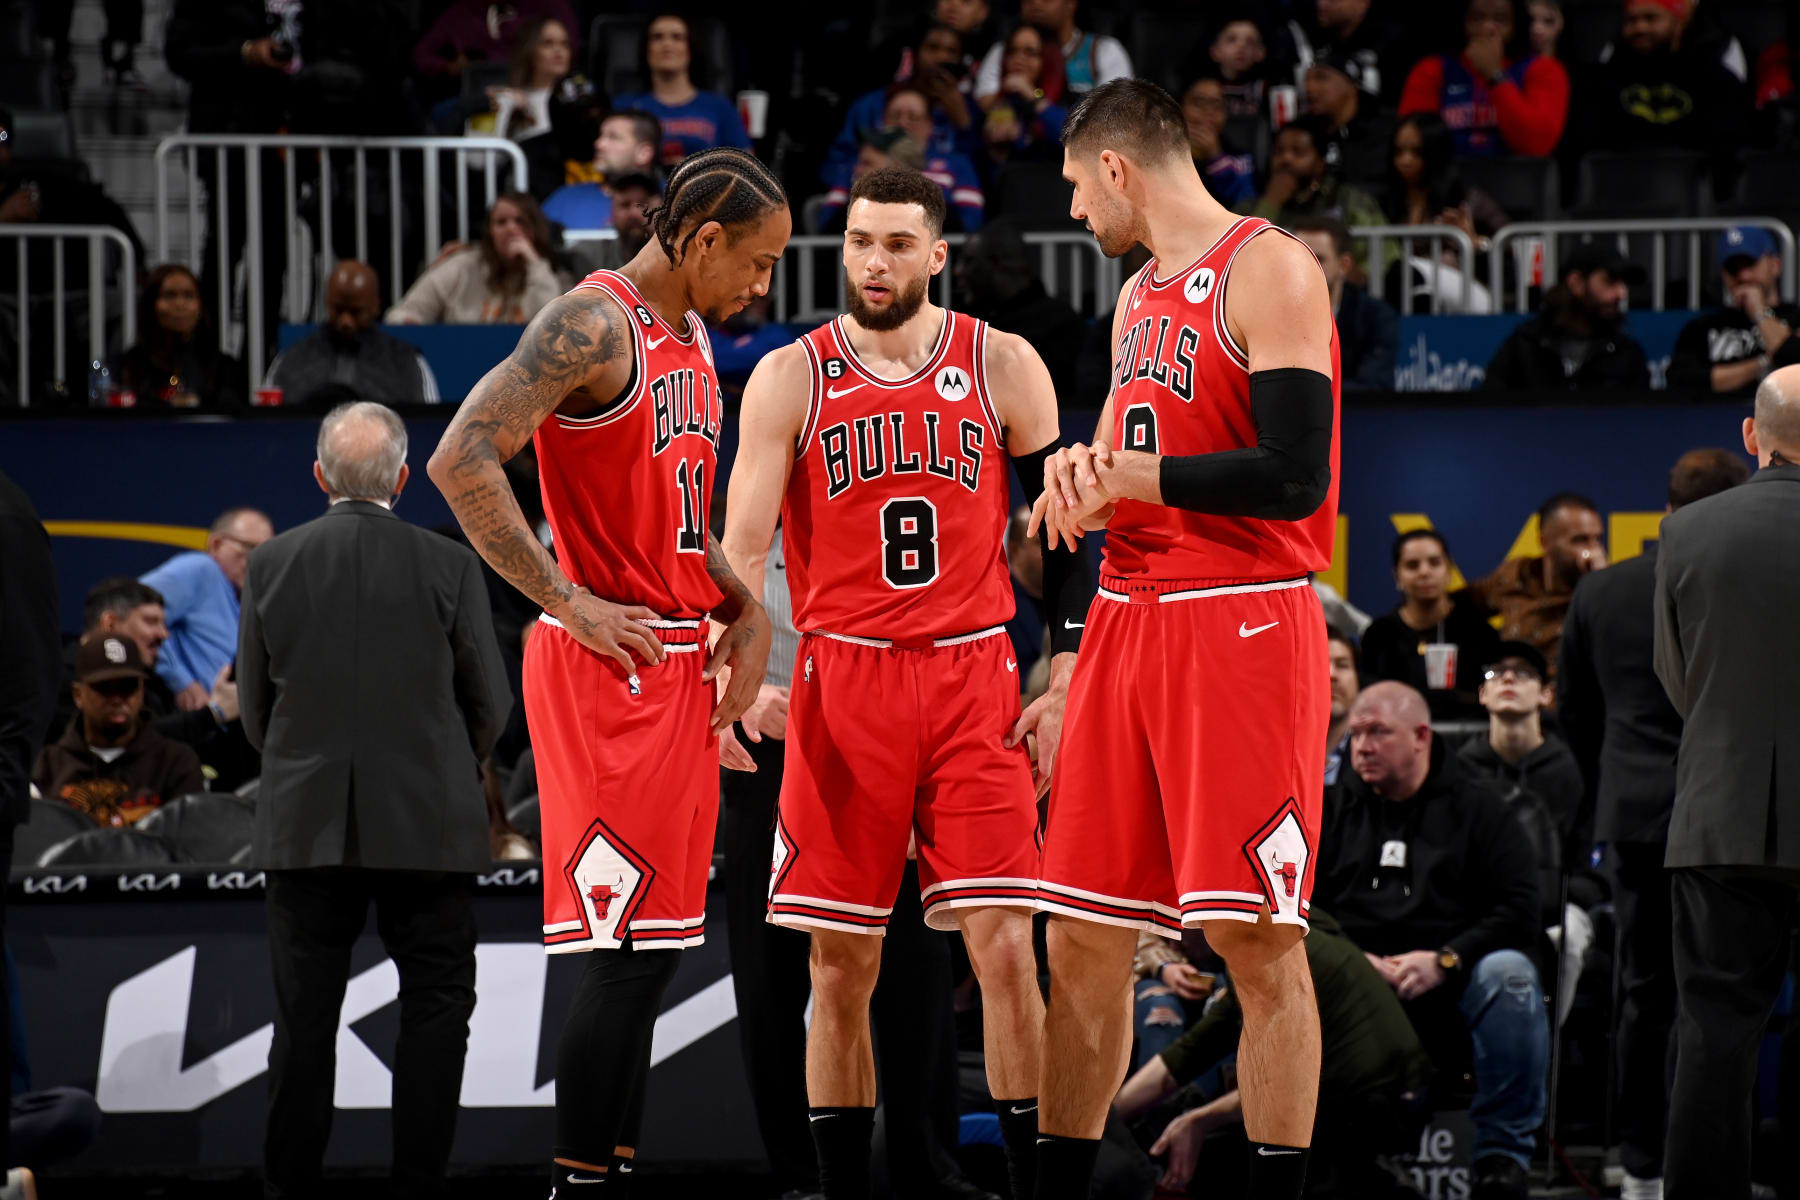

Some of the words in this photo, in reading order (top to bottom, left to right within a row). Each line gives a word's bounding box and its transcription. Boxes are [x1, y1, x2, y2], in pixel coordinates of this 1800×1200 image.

[636, 307, 652, 325] 6
[826, 360, 842, 377] 6
[819, 411, 985, 501] BULLS
[676, 457, 705, 555] 11
[879, 496, 940, 590] 8
